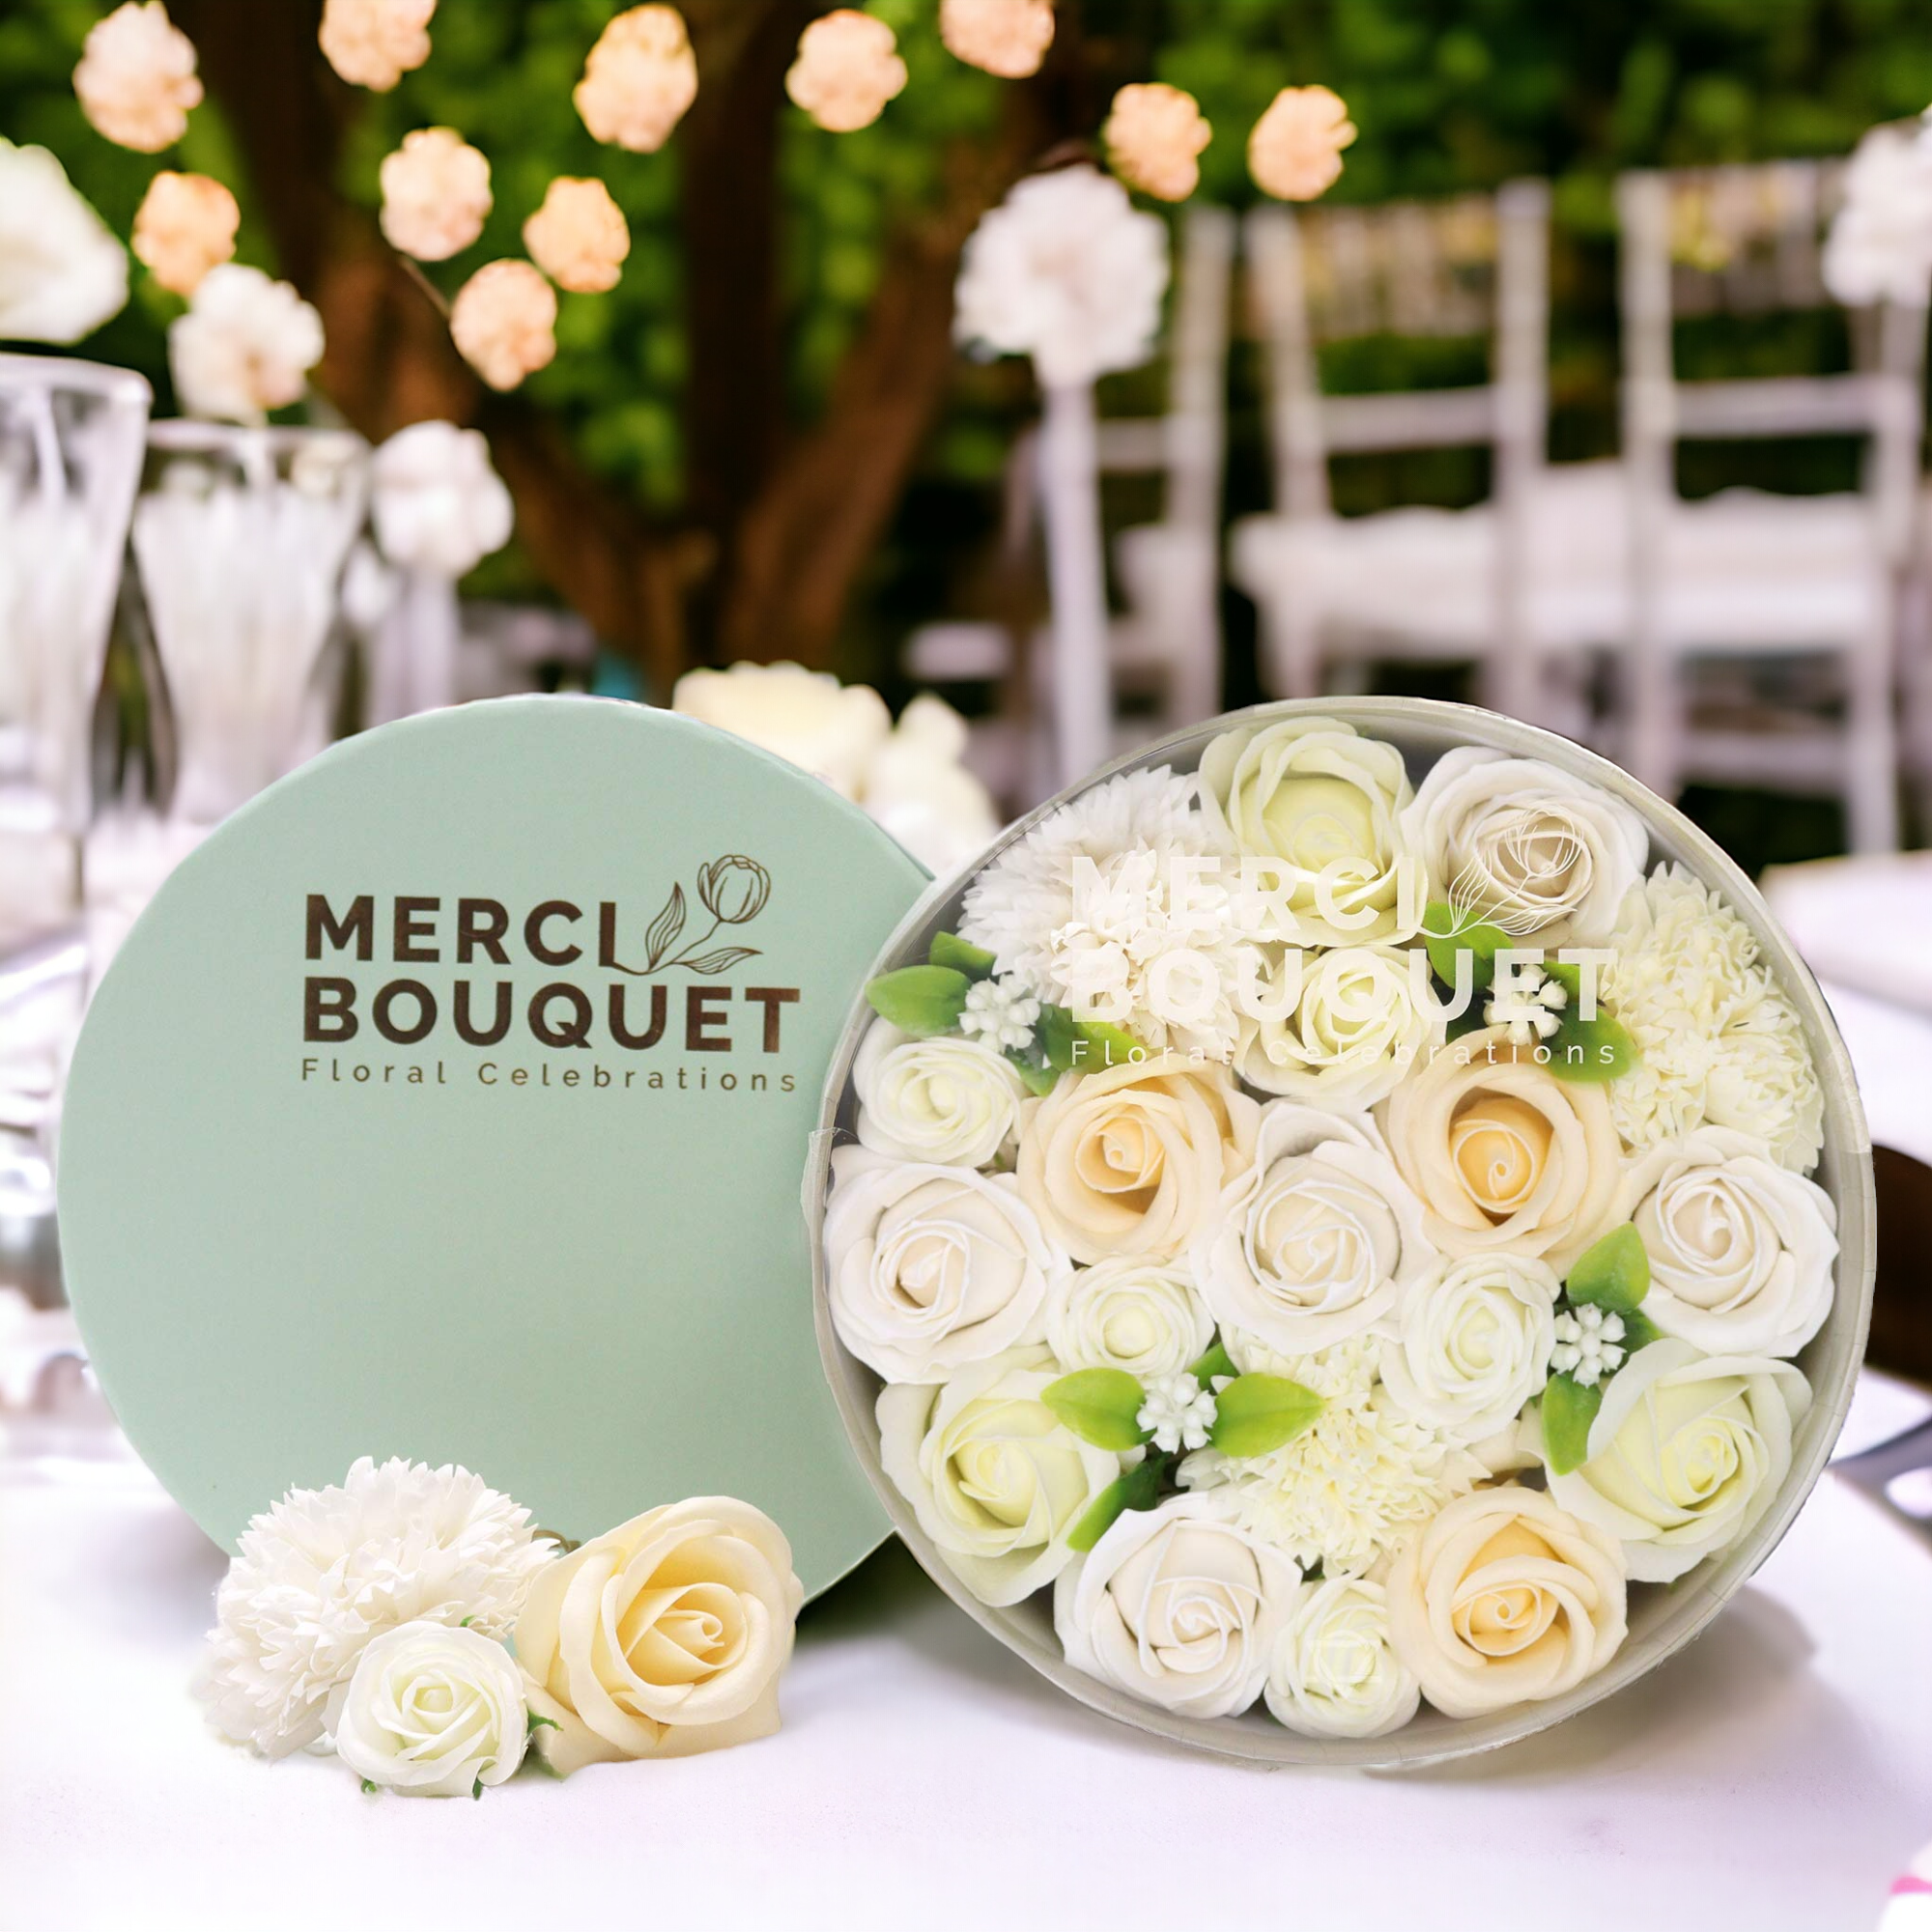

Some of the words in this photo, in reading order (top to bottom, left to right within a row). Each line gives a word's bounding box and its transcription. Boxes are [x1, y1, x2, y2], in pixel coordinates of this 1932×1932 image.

[1072, 856, 1414, 930] MERCI
[305, 894, 616, 967] MERCI
[303, 977, 800, 1053] BOUQUET
[1072, 949, 1618, 1023] BOUQUET
[301, 1059, 445, 1084] Floral
[477, 1063, 796, 1093] Celebrations
[1071, 1040, 1232, 1065] Floral
[1268, 1040, 1615, 1065] Celebrations
